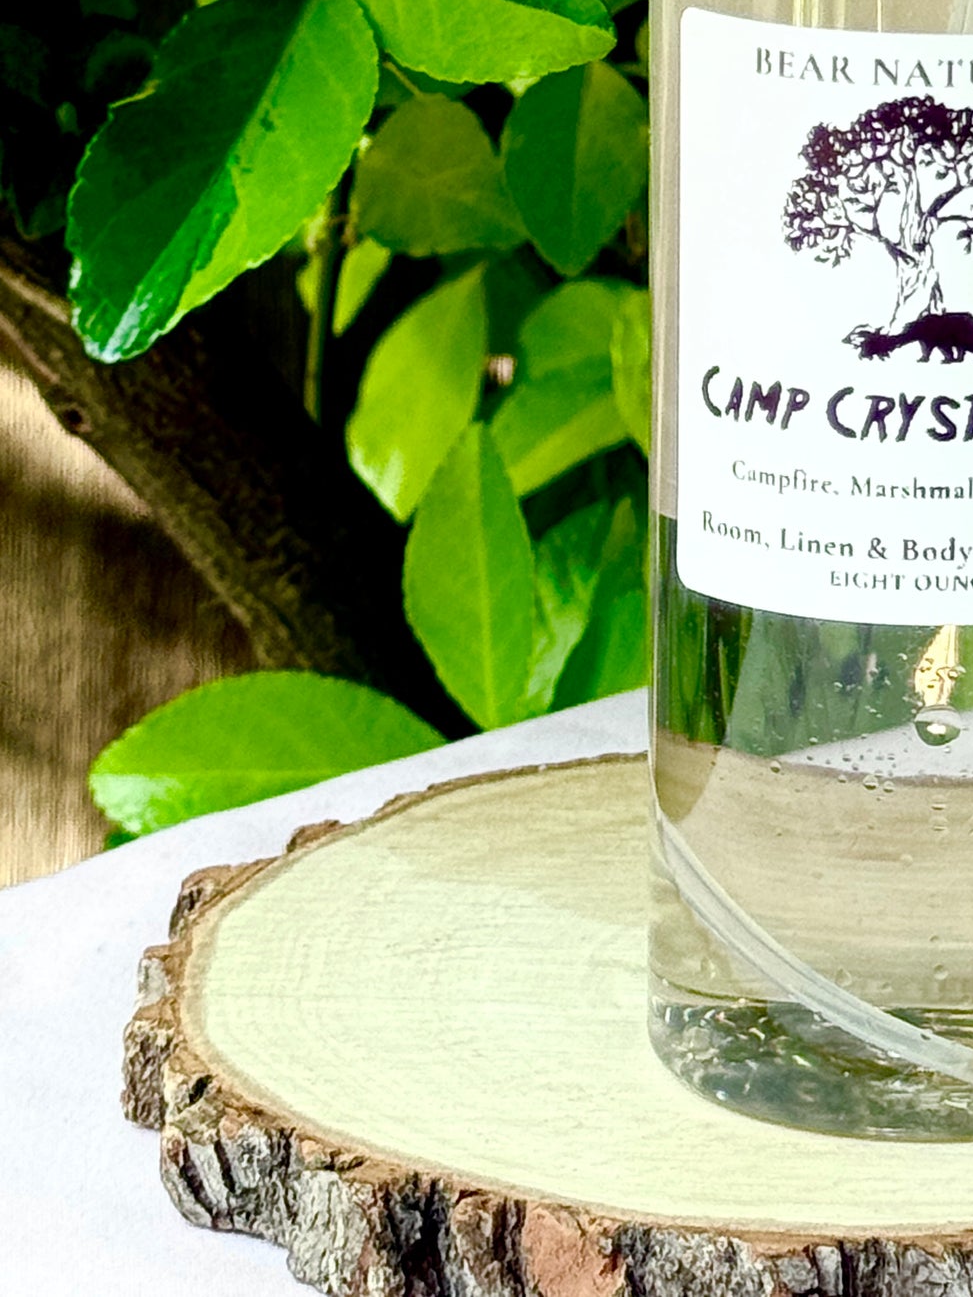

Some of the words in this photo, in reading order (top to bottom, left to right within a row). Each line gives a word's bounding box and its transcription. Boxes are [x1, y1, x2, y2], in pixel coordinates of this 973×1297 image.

[755, 47, 855, 84] BEAR
[701, 365, 810, 430] CAMP
[701, 510, 770, 549] Room,
[780, 527, 854, 559] Linen
[867, 537, 888, 561] &
[902, 536, 973, 570] Body
[829, 570, 906, 592] EIGHT
